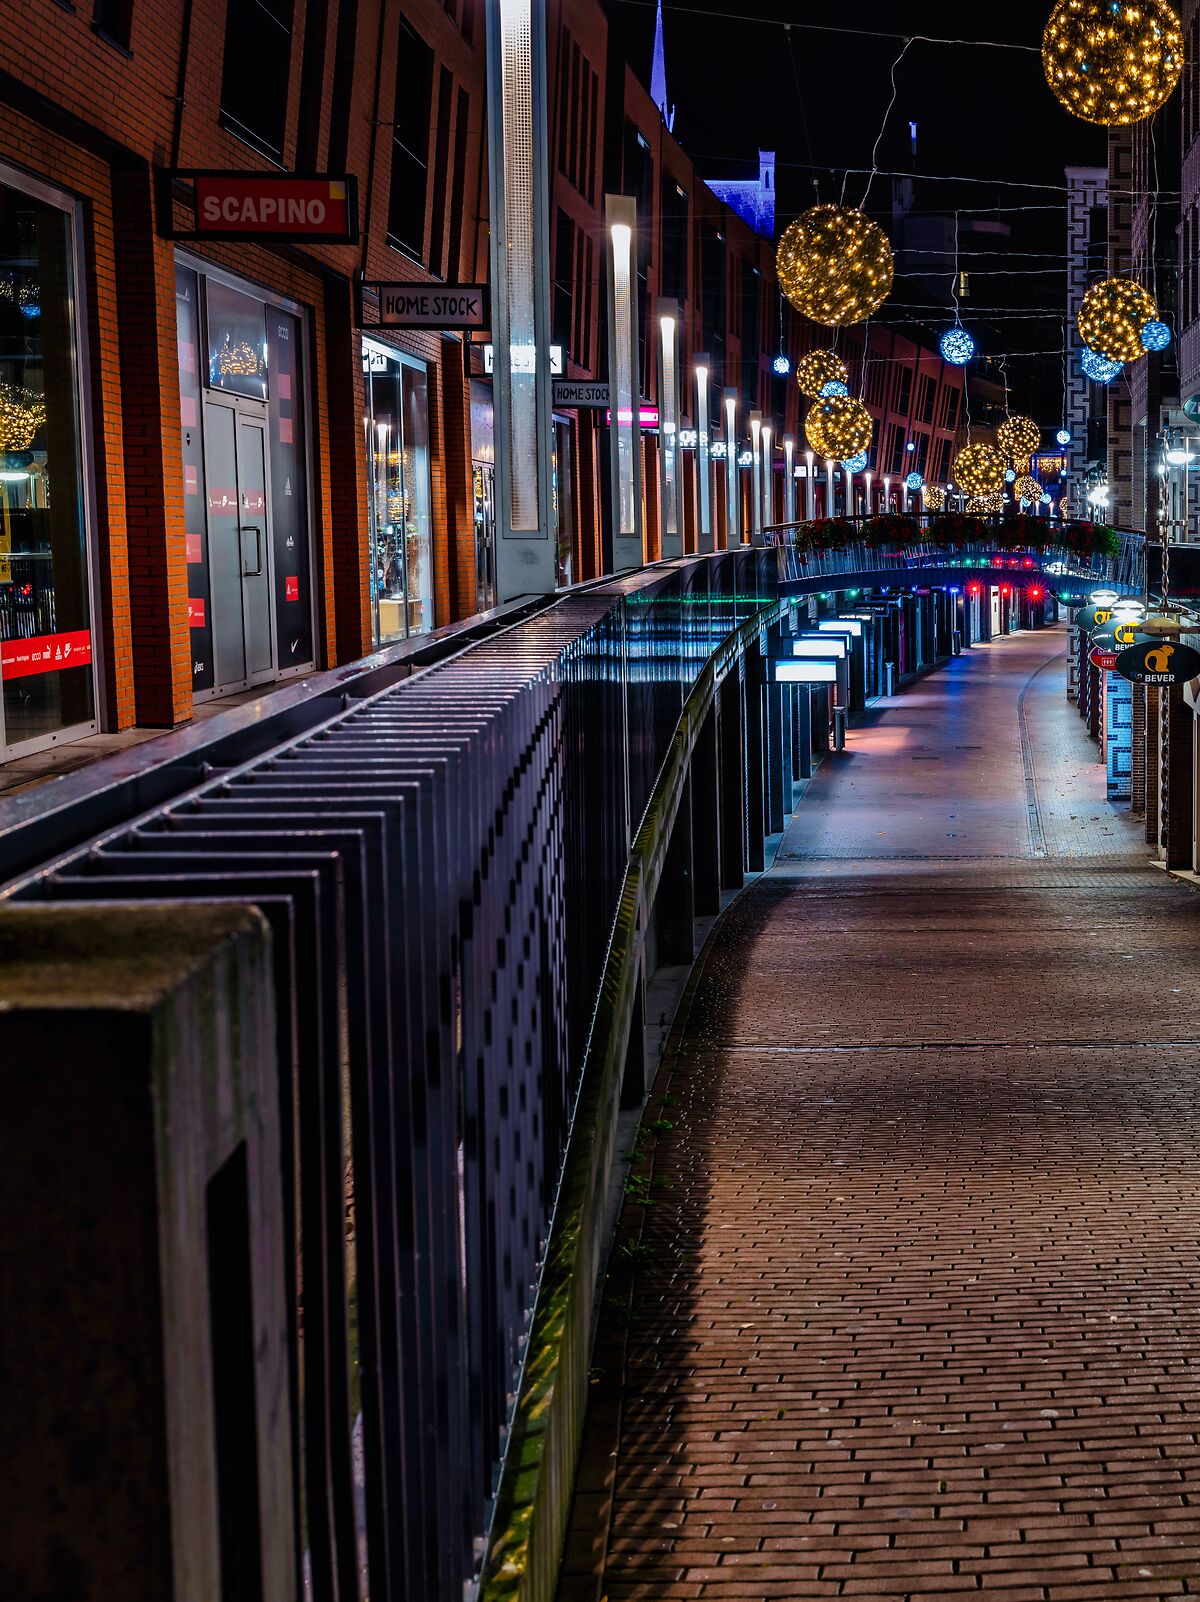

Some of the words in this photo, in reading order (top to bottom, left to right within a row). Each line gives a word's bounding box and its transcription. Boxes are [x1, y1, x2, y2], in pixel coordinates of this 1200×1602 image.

[203, 195, 326, 225] SCAPINO
[386, 296, 429, 316] HOME
[432, 296, 478, 317] STOCK
[557, 388, 583, 400] HOME
[1144, 674, 1175, 682] BEVER
